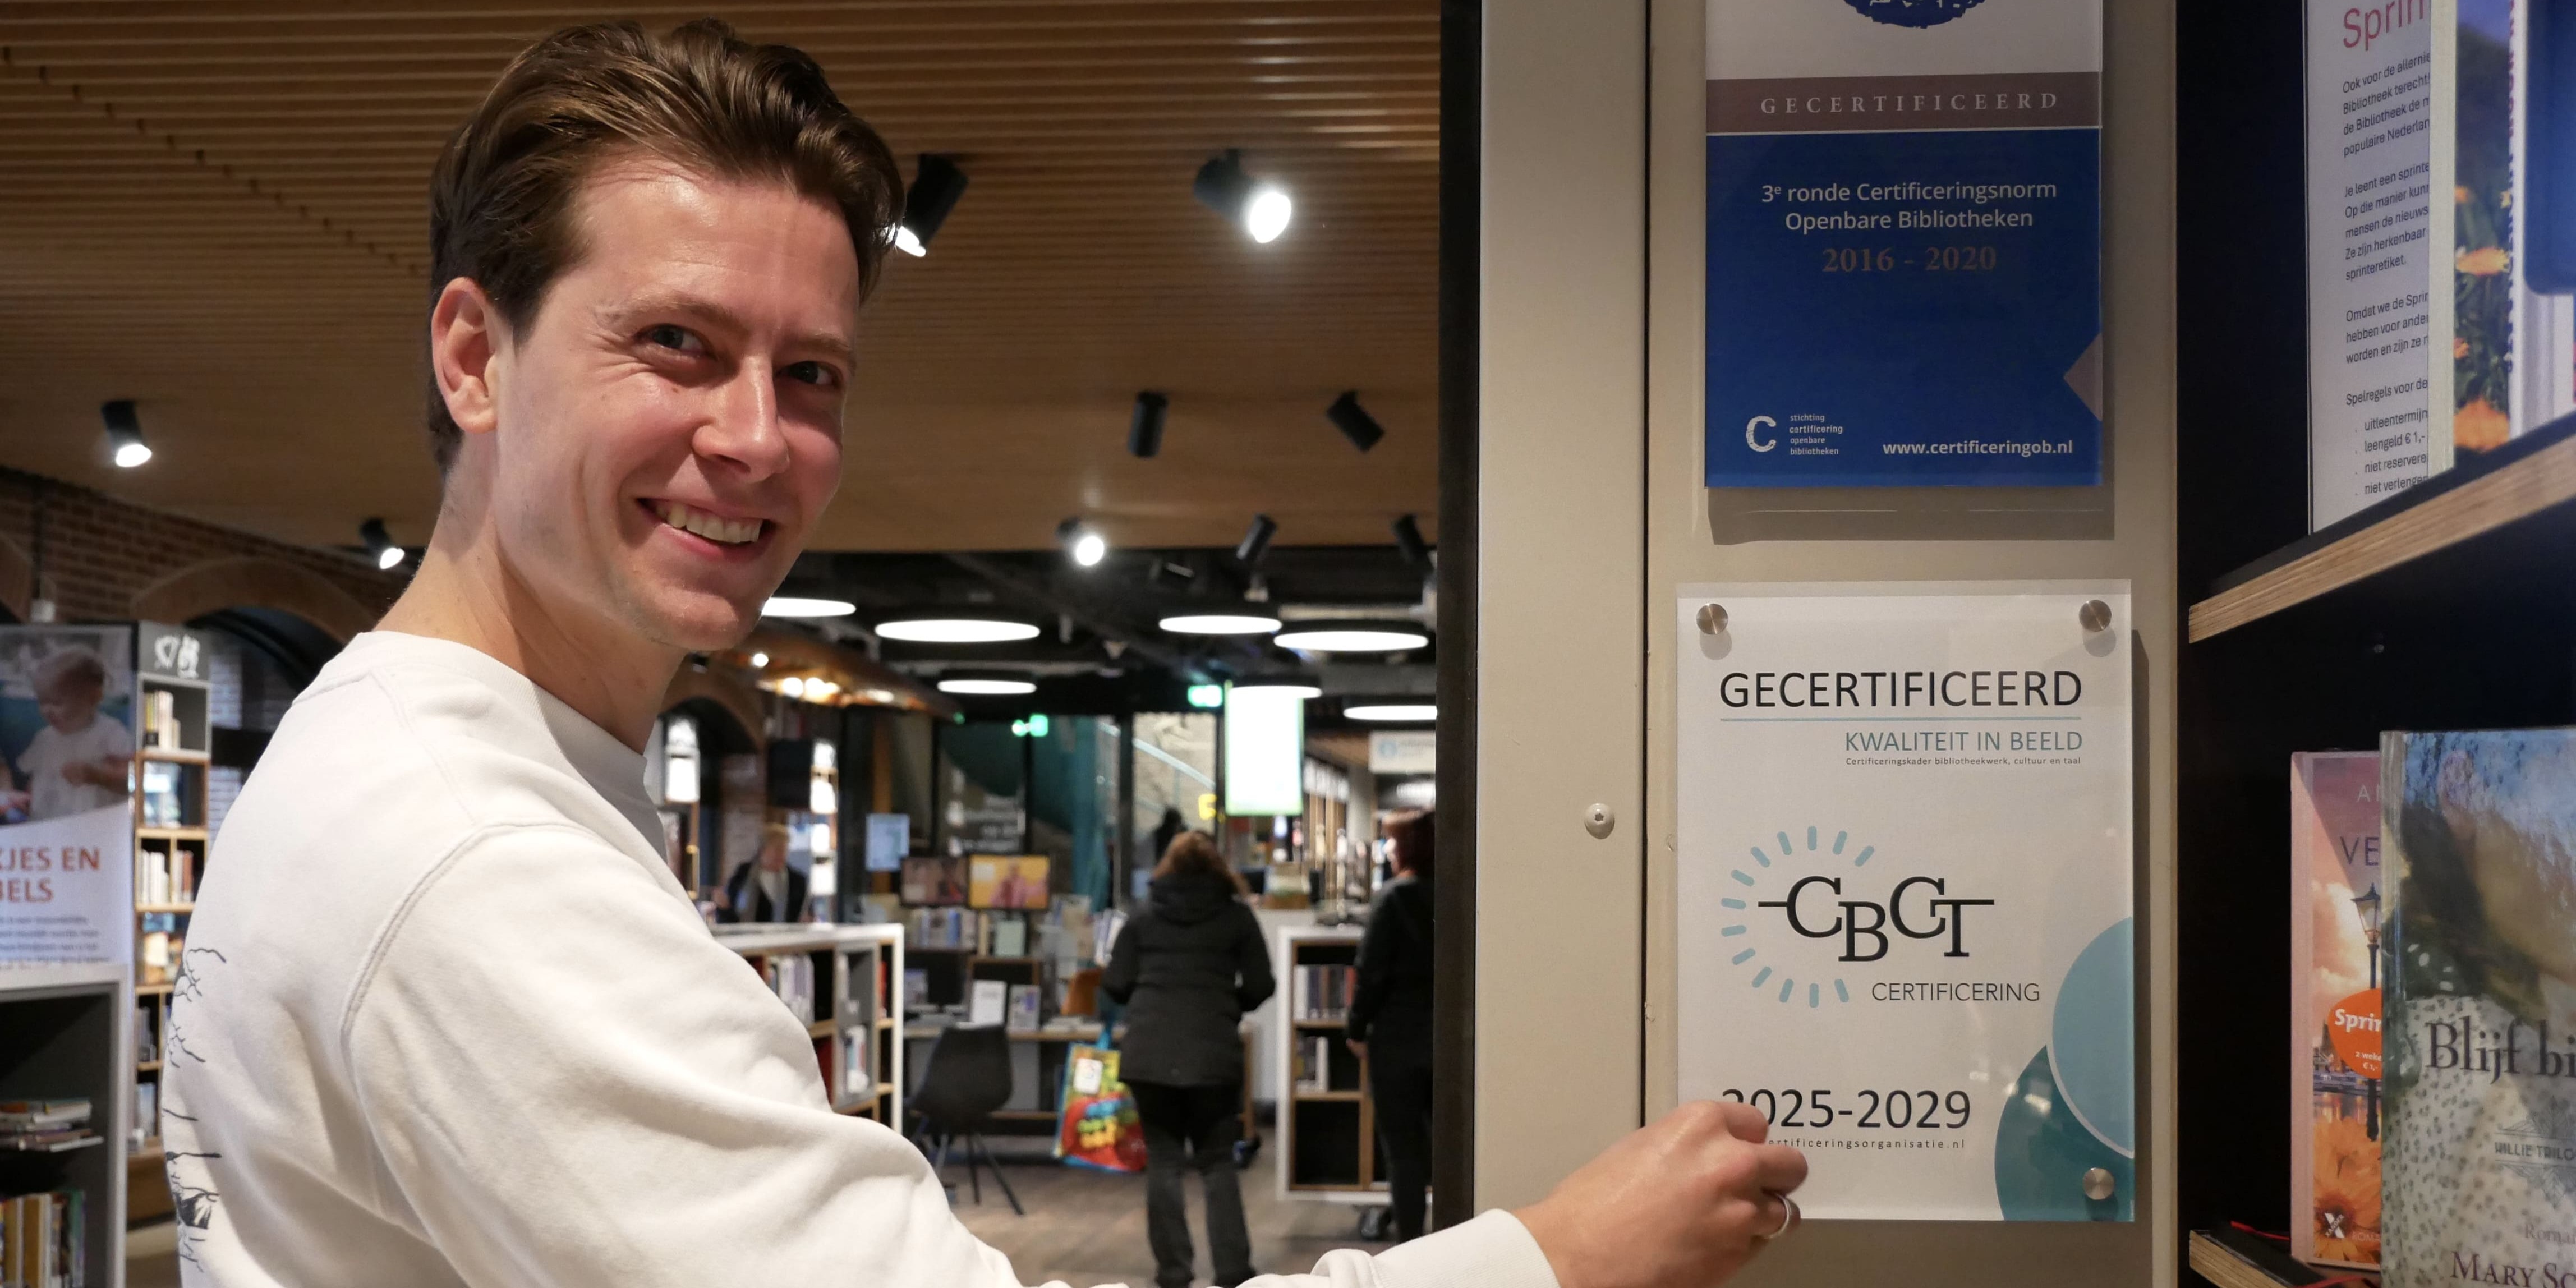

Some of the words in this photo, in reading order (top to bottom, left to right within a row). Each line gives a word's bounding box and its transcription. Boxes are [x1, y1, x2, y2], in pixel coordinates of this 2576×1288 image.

[2343, 77, 2361, 93] Ook
[2362, 71, 2382, 86] voor
[2384, 65, 2395, 78] de
[1760, 92, 2057, 114] GECERTIFICEERD
[2343, 87, 2393, 114] Bibliotheek
[2343, 123, 2354, 136] de
[2356, 103, 2407, 131] Bibliotheek
[2408, 100, 2420, 112] de
[2344, 134, 2385, 158] populaire
[1787, 183, 1850, 202] ronde
[1856, 182, 2057, 204] Certificeringsnorm
[2344, 186, 2353, 197] Je
[2356, 178, 2377, 194] leent
[2380, 173, 2396, 186] een
[2345, 206, 2358, 219] Op
[2360, 200, 2373, 214] die
[2375, 190, 2407, 208] manier
[1785, 211, 1892, 235] Openbare
[1898, 209, 2034, 229] Bibliotheken
[2345, 220, 2380, 239] mensen
[2382, 215, 2393, 228] de
[2395, 205, 2429, 223] nieuws
[2345, 247, 2356, 260] Ze
[2357, 243, 2372, 256] zijn
[2373, 228, 2426, 251] herkenbaar
[1821, 247, 1894, 273] 2016
[1925, 246, 1997, 272] 2020
[2345, 255, 2407, 281] sprinteretiket.
[2346, 305, 2376, 322] Omdat
[2377, 302, 2390, 314] we
[2392, 298, 2404, 310] de
[2346, 326, 2379, 343] hebben
[2381, 320, 2400, 334] voor
[2345, 347, 2379, 364] worden
[2380, 345, 2392, 356] en
[2393, 339, 2409, 354] zijn
[2411, 337, 2421, 348] ze
[2346, 385, 2392, 407] Spelregels
[2394, 382, 2414, 395] voor
[2416, 378, 2428, 390] de
[1789, 425, 1843, 434] certificering
[1790, 413, 1825, 422] stichting
[2365, 407, 2428, 431] uitleentermijn
[1882, 440, 2073, 457] www.certificeringob.nl
[2365, 434, 2403, 452] leengeld
[2404, 432, 2411, 444] €
[2365, 461, 2382, 473] niet
[2384, 453, 2427, 470] reservere
[2365, 482, 2381, 495] niet
[1719, 670, 2082, 707] GECERTIFICEERD
[1845, 731, 1970, 751] KWALITEIT
[1977, 731, 2001, 751] IN
[2010, 731, 2083, 751] BEELD
[1845, 757, 1932, 766] Certificeringskader
[1934, 757, 2011, 766] bibliotheekwerk,
[2013, 757, 2047, 765] cultuur
[0, 846, 53, 871] JES
[61, 845, 102, 872] EN
[0, 877, 54, 903] ELS
[1871, 982, 2040, 1002] CERTIFICERING
[2423, 1015, 2524, 1085] Blijf
[2450, 1250, 2536, 1288] MARY
